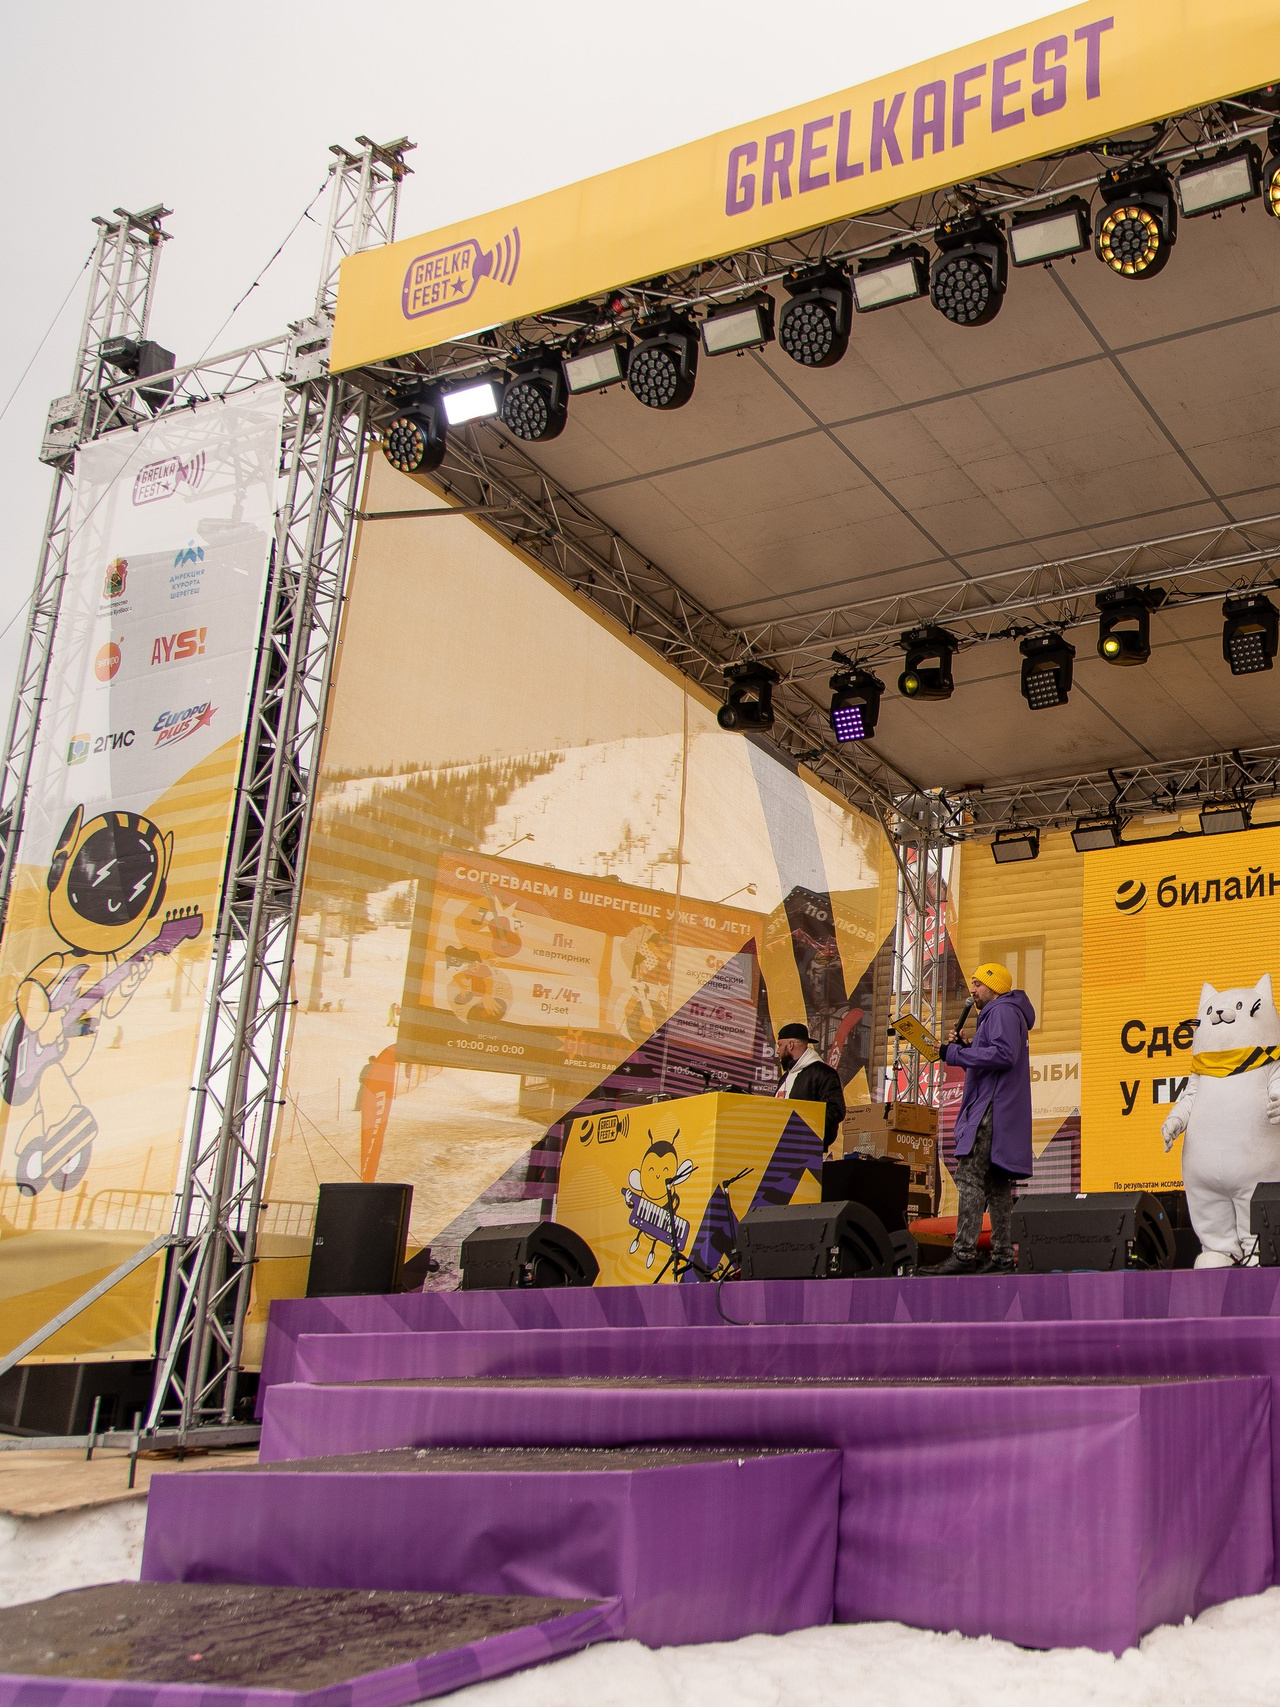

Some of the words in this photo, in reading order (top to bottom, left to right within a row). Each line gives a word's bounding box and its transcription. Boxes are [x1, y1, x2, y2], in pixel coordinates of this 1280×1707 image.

[725, 16, 1114, 217] GRELKAFEST
[415, 248, 471, 285] GRELKA
[412, 279, 450, 310] FEST
[142, 463, 176, 484] GRELKA
[138, 482, 162, 500] FEST
[169, 569, 205, 583] ДИРЕКЦИЯ
[170, 588, 200, 600] ШЕРЕГЕШ
[171, 580, 200, 591] КУРОРТА
[151, 626, 208, 666] AYS!
[93, 730, 136, 753] 2ГИС
[455, 866, 558, 898] СОГРЕВАЕМ
[563, 888, 574, 900] В
[579, 890, 661, 918] ШЕРЕГЕШЕ
[666, 908, 698, 926] УЖЕ
[703, 914, 716, 929] 10
[720, 919, 751, 935] ЛЕТ!
[805, 904, 828, 921] ПО
[552, 933, 575, 949] Пн.
[533, 948, 591, 965] квартирник
[686, 969, 744, 985] акустический
[541, 1002, 569, 1016] Dj-set
[456, 1039, 484, 1050] 10:00
[486, 1044, 499, 1053] до
[502, 1044, 525, 1055] 0:00
[1121, 1019, 1194, 1058] Сде
[563, 1058, 587, 1068] APRES
[588, 1061, 600, 1070] SKI
[1119, 1080, 1141, 1116] у
[601, 1118, 617, 1130] GRELKA
[600, 1129, 611, 1141] FEST
[1114, 1181, 1122, 1190] По
[1124, 1181, 1159, 1191] результатам
[1160, 1180, 1184, 1188] исследо
